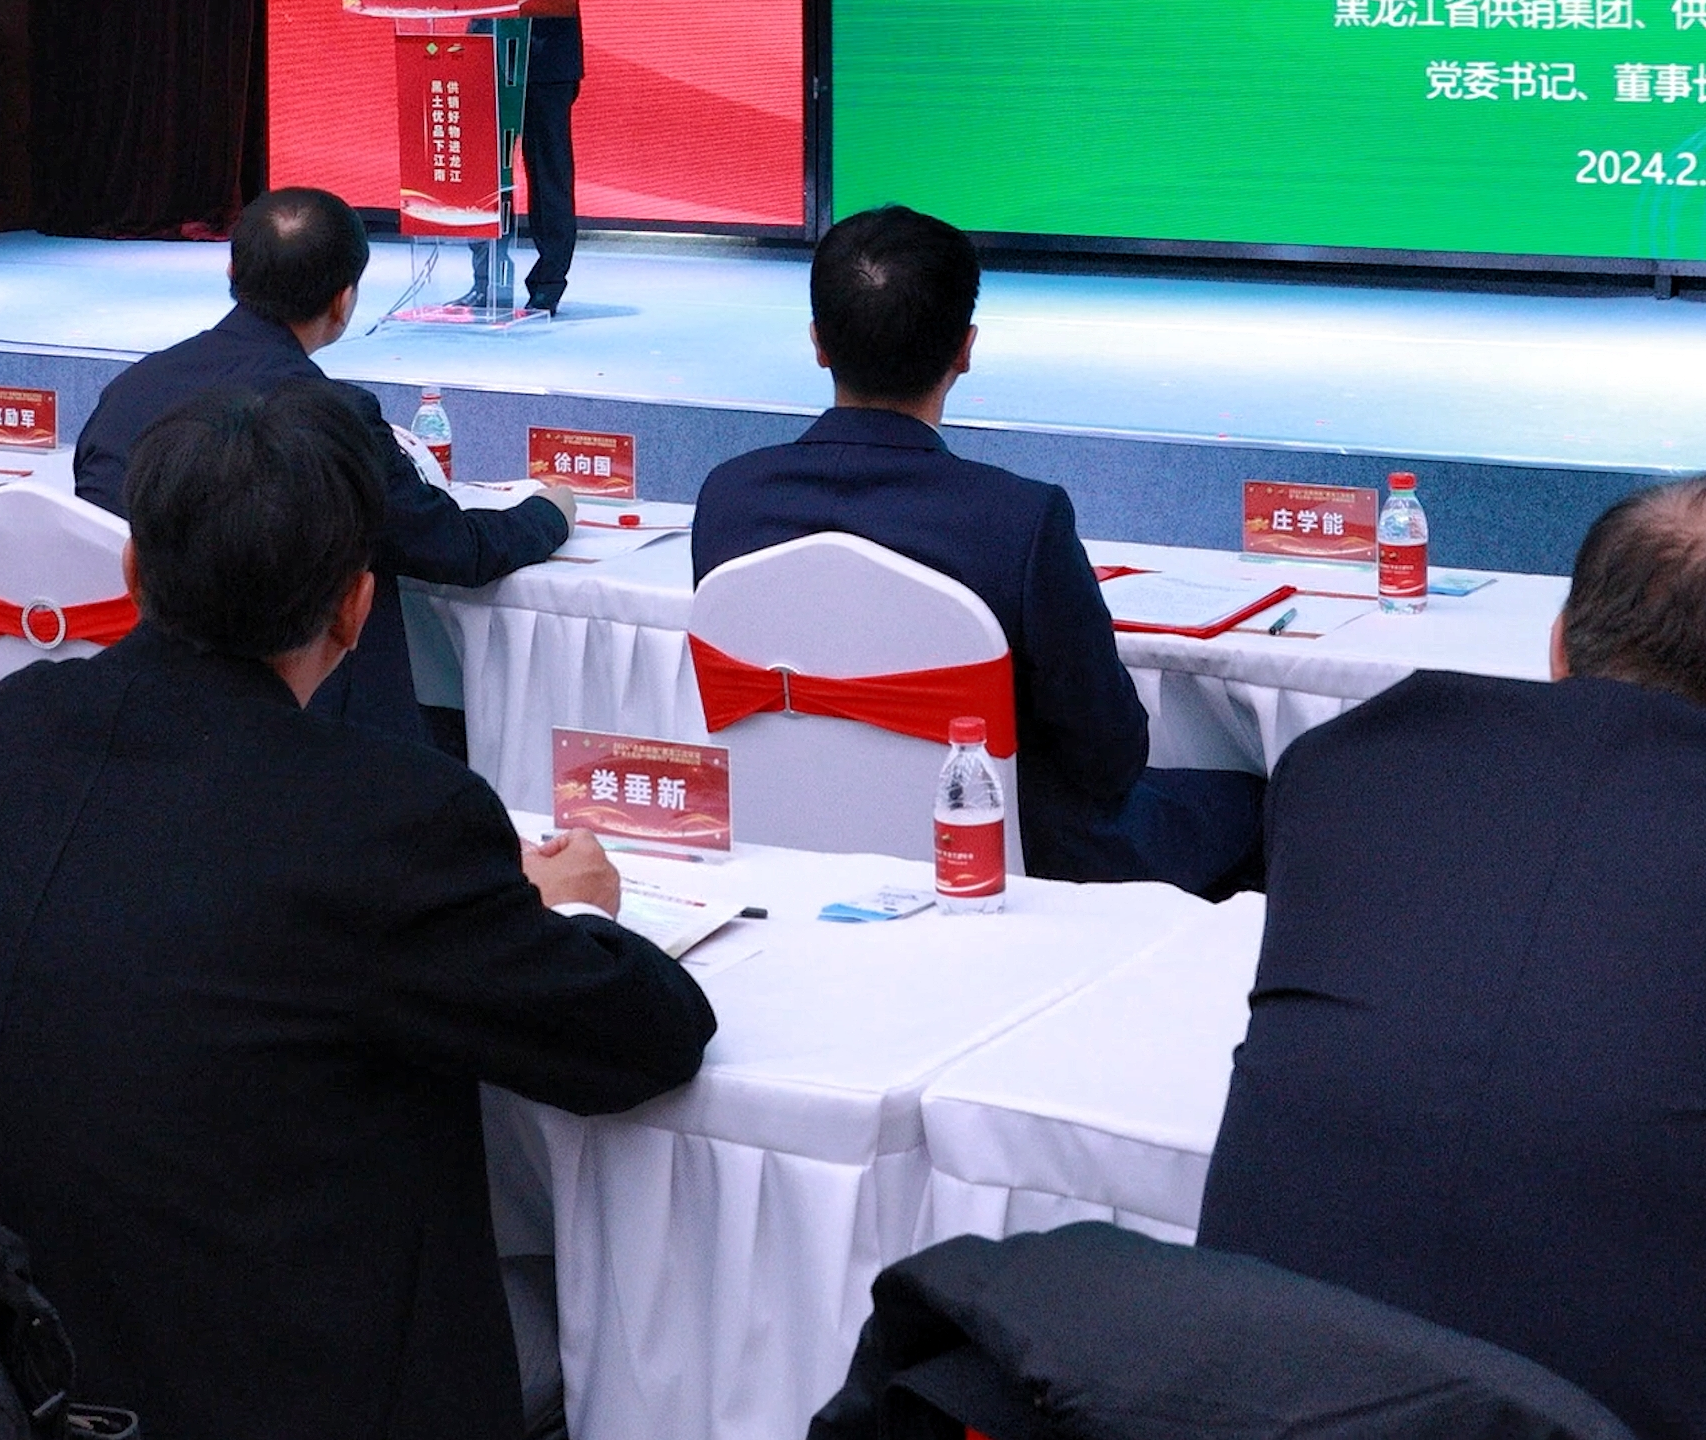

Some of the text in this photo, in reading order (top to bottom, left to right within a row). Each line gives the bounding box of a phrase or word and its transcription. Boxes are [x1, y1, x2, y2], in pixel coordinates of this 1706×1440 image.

[554, 452, 611, 477] 徐向国
[1272, 508, 1345, 536] 庄学能
[591, 768, 687, 811] 娄垂新
